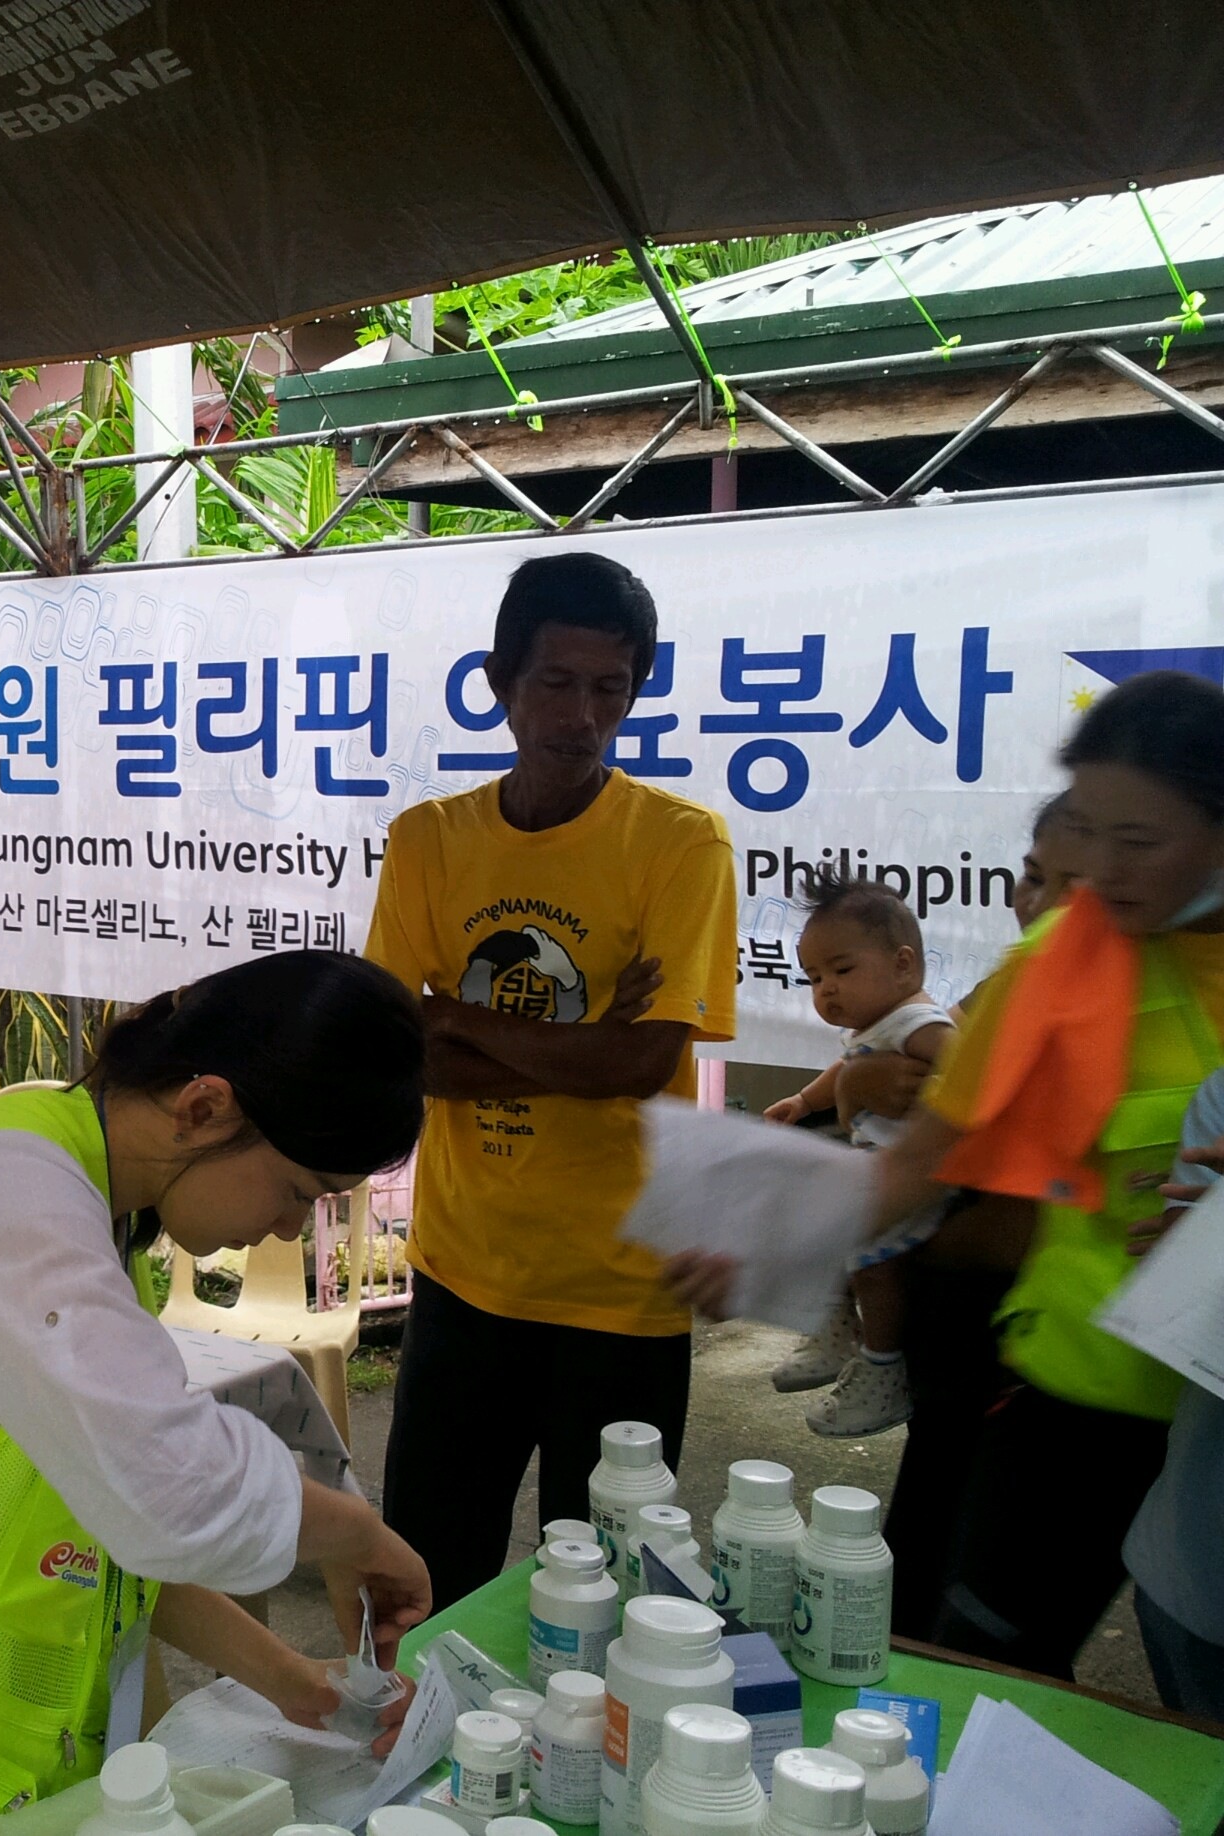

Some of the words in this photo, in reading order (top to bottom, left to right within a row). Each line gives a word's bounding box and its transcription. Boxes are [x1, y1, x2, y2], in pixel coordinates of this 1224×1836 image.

[16, 39, 117, 97] JUN
[98, 652, 391, 798] 필리핀
[145, 829, 348, 889] University
[746, 846, 1017, 920] Philippin
[35, 894, 188, 948] 마르셀리노,
[200, 904, 234, 949] 산
[482, 1140, 513, 1157] 2011
